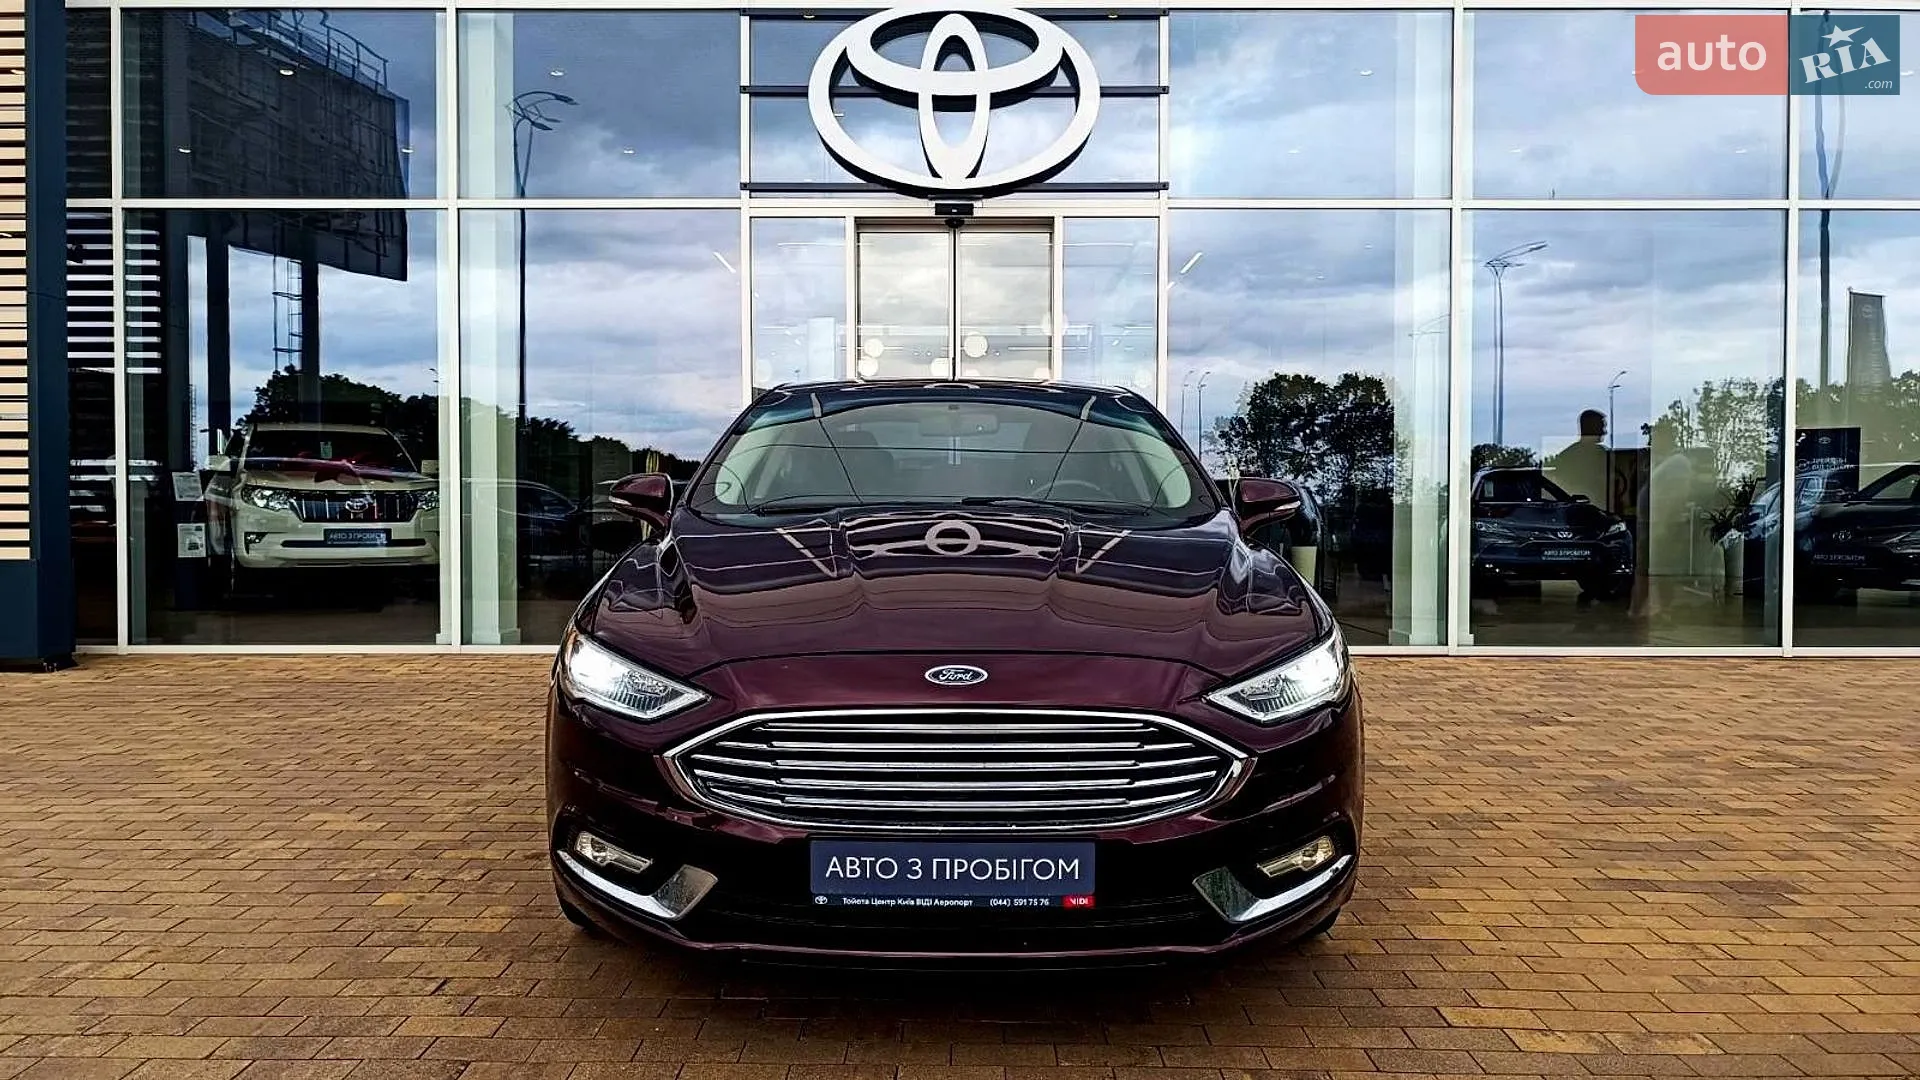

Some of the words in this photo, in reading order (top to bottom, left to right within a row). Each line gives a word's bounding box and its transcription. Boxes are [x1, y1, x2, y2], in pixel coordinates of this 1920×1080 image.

[939, 668, 974, 681] Ford
[825, 856, 898, 879] АВТО
[906, 858, 923, 880] З
[932, 857, 1080, 881] ПРОБІГОМ
[842, 897, 869, 906] Тойота
[871, 897, 896, 908] Центр
[934, 898, 974, 908] Аеропорт
[990, 897, 1011, 908] (044)
